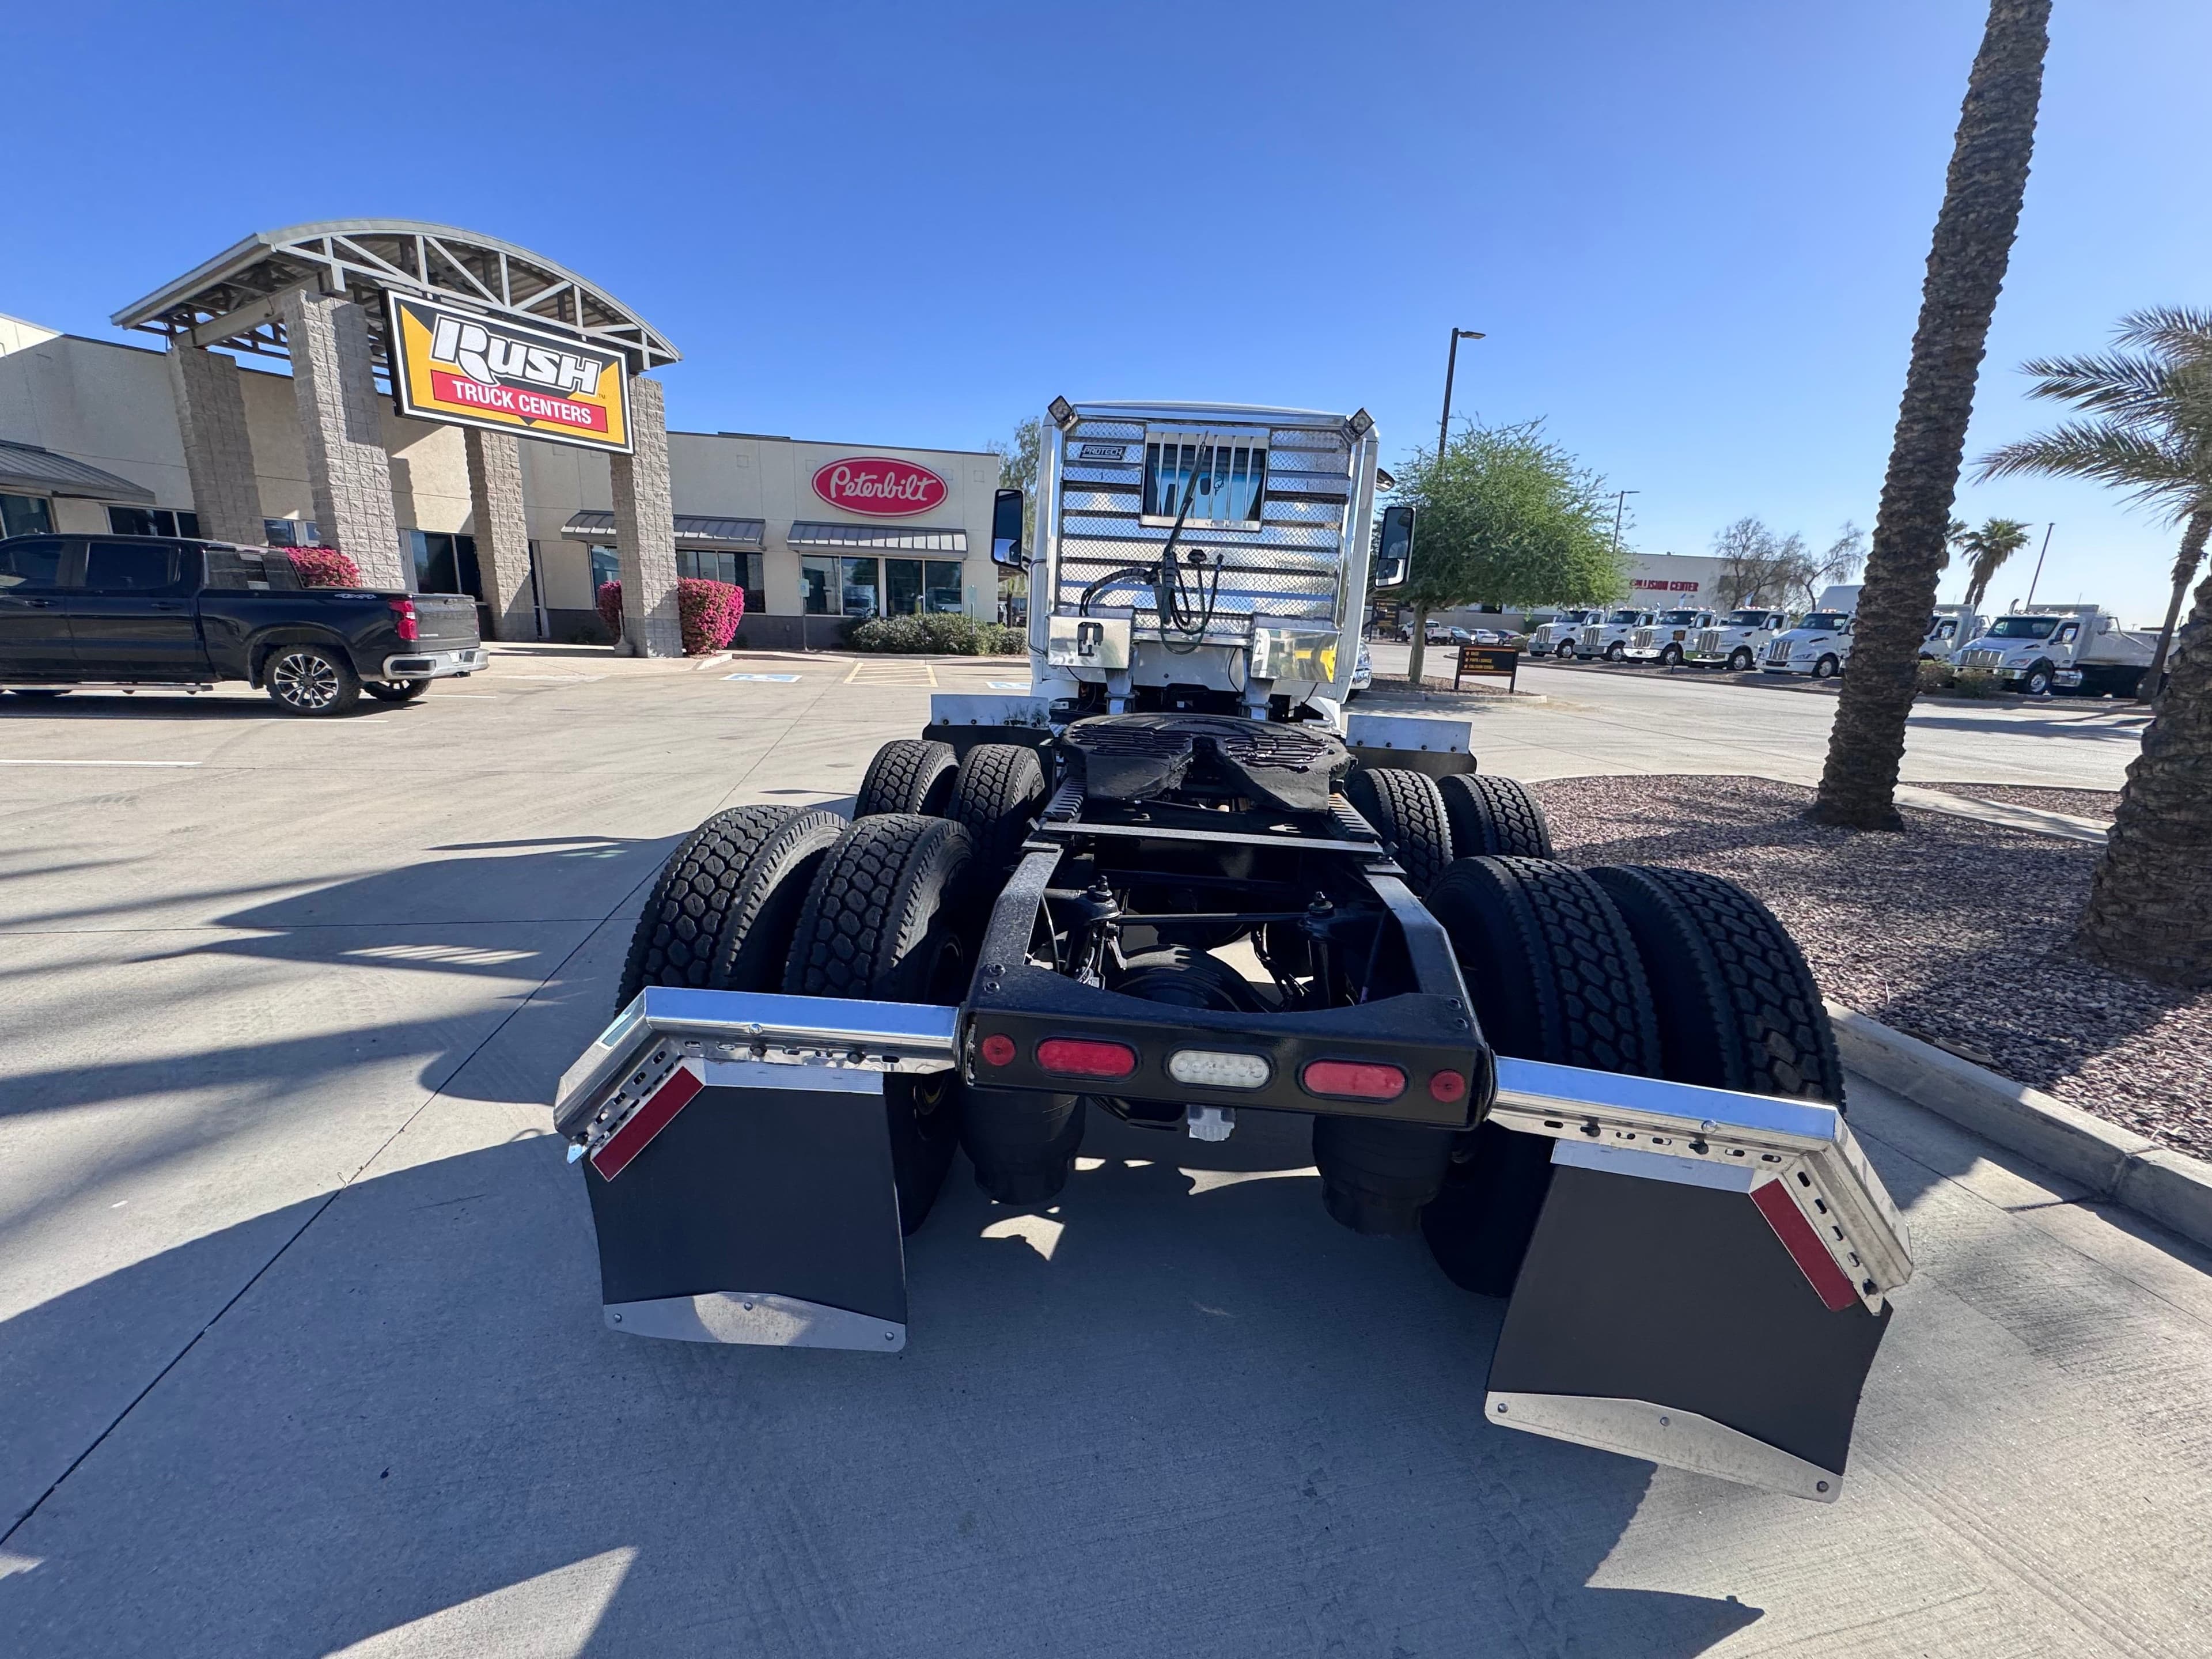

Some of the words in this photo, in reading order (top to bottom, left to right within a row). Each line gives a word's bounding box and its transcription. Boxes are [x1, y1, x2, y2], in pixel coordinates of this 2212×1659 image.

[452, 380, 515, 409] TRUCK
[519, 394, 592, 425] CENTERS
[1082, 448, 1123, 456] PROTECH
[830, 465, 937, 501] Peterbilt
[1670, 581, 1699, 592] CENTER
